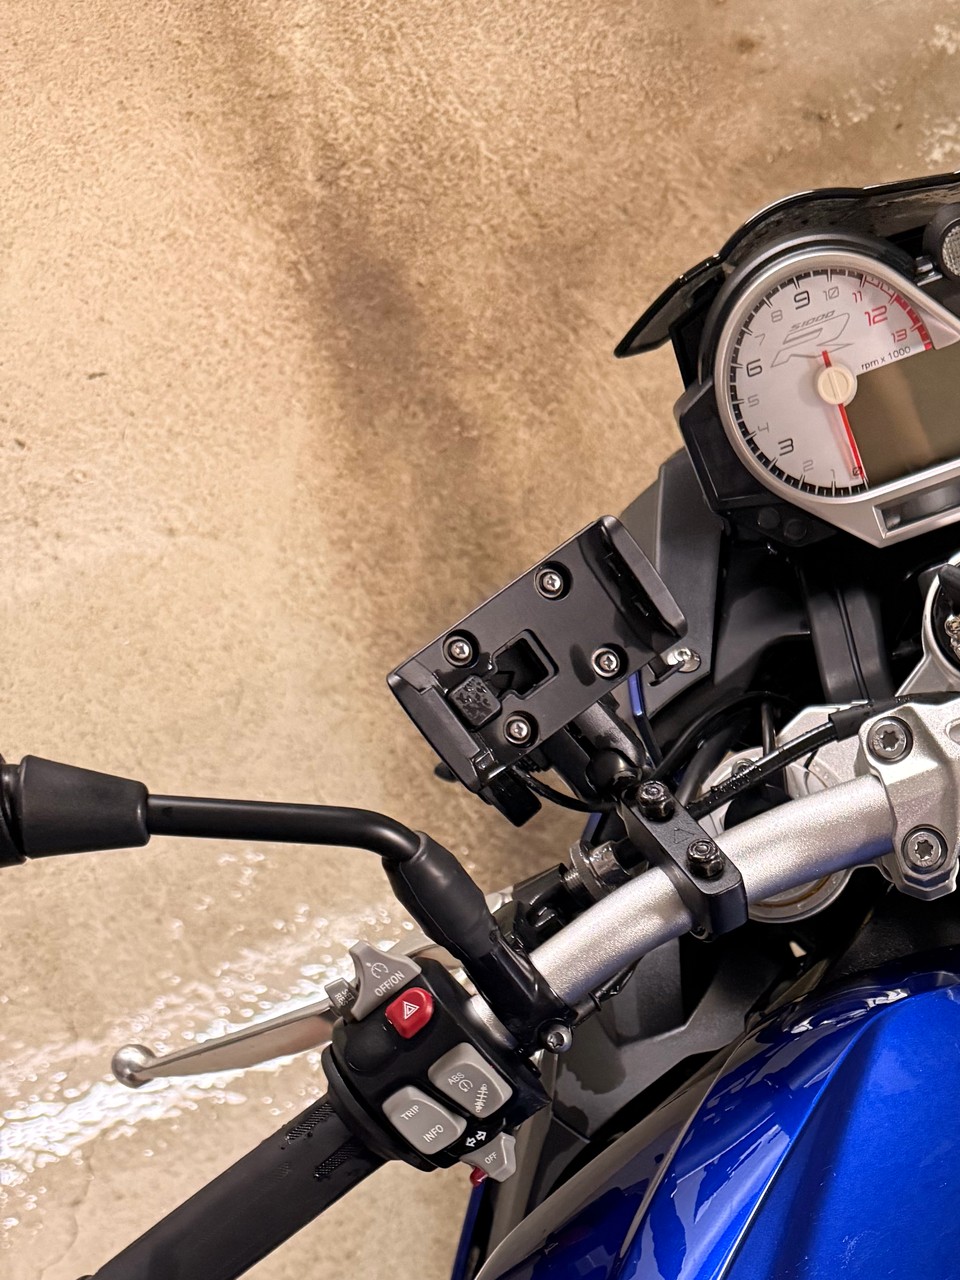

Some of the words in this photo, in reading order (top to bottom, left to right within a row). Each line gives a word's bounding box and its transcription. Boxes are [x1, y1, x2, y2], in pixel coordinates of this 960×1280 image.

[793, 290, 811, 310] 9
[823, 286, 840, 301] 10
[852, 290, 863, 304] 11
[770, 309, 783, 323] 8
[864, 305, 888, 326] 12
[754, 333, 766, 346] 7
[891, 328, 908, 343] 13
[861, 358, 880, 371] rpm
[888, 346, 911, 360] 1000
[746, 358, 762, 377] 6
[747, 394, 760, 408] 5
[757, 421, 770, 434] 4
[778, 438, 794, 456] 3
[802, 459, 814, 472] 2
[830, 468, 836, 479] 1
[374, 970, 405, 997] OFF/ON
[447, 1072, 465, 1085] ABS
[400, 1104, 420, 1121] TRIP
[422, 1123, 444, 1143] INFO
[484, 1151, 498, 1165] OFF
